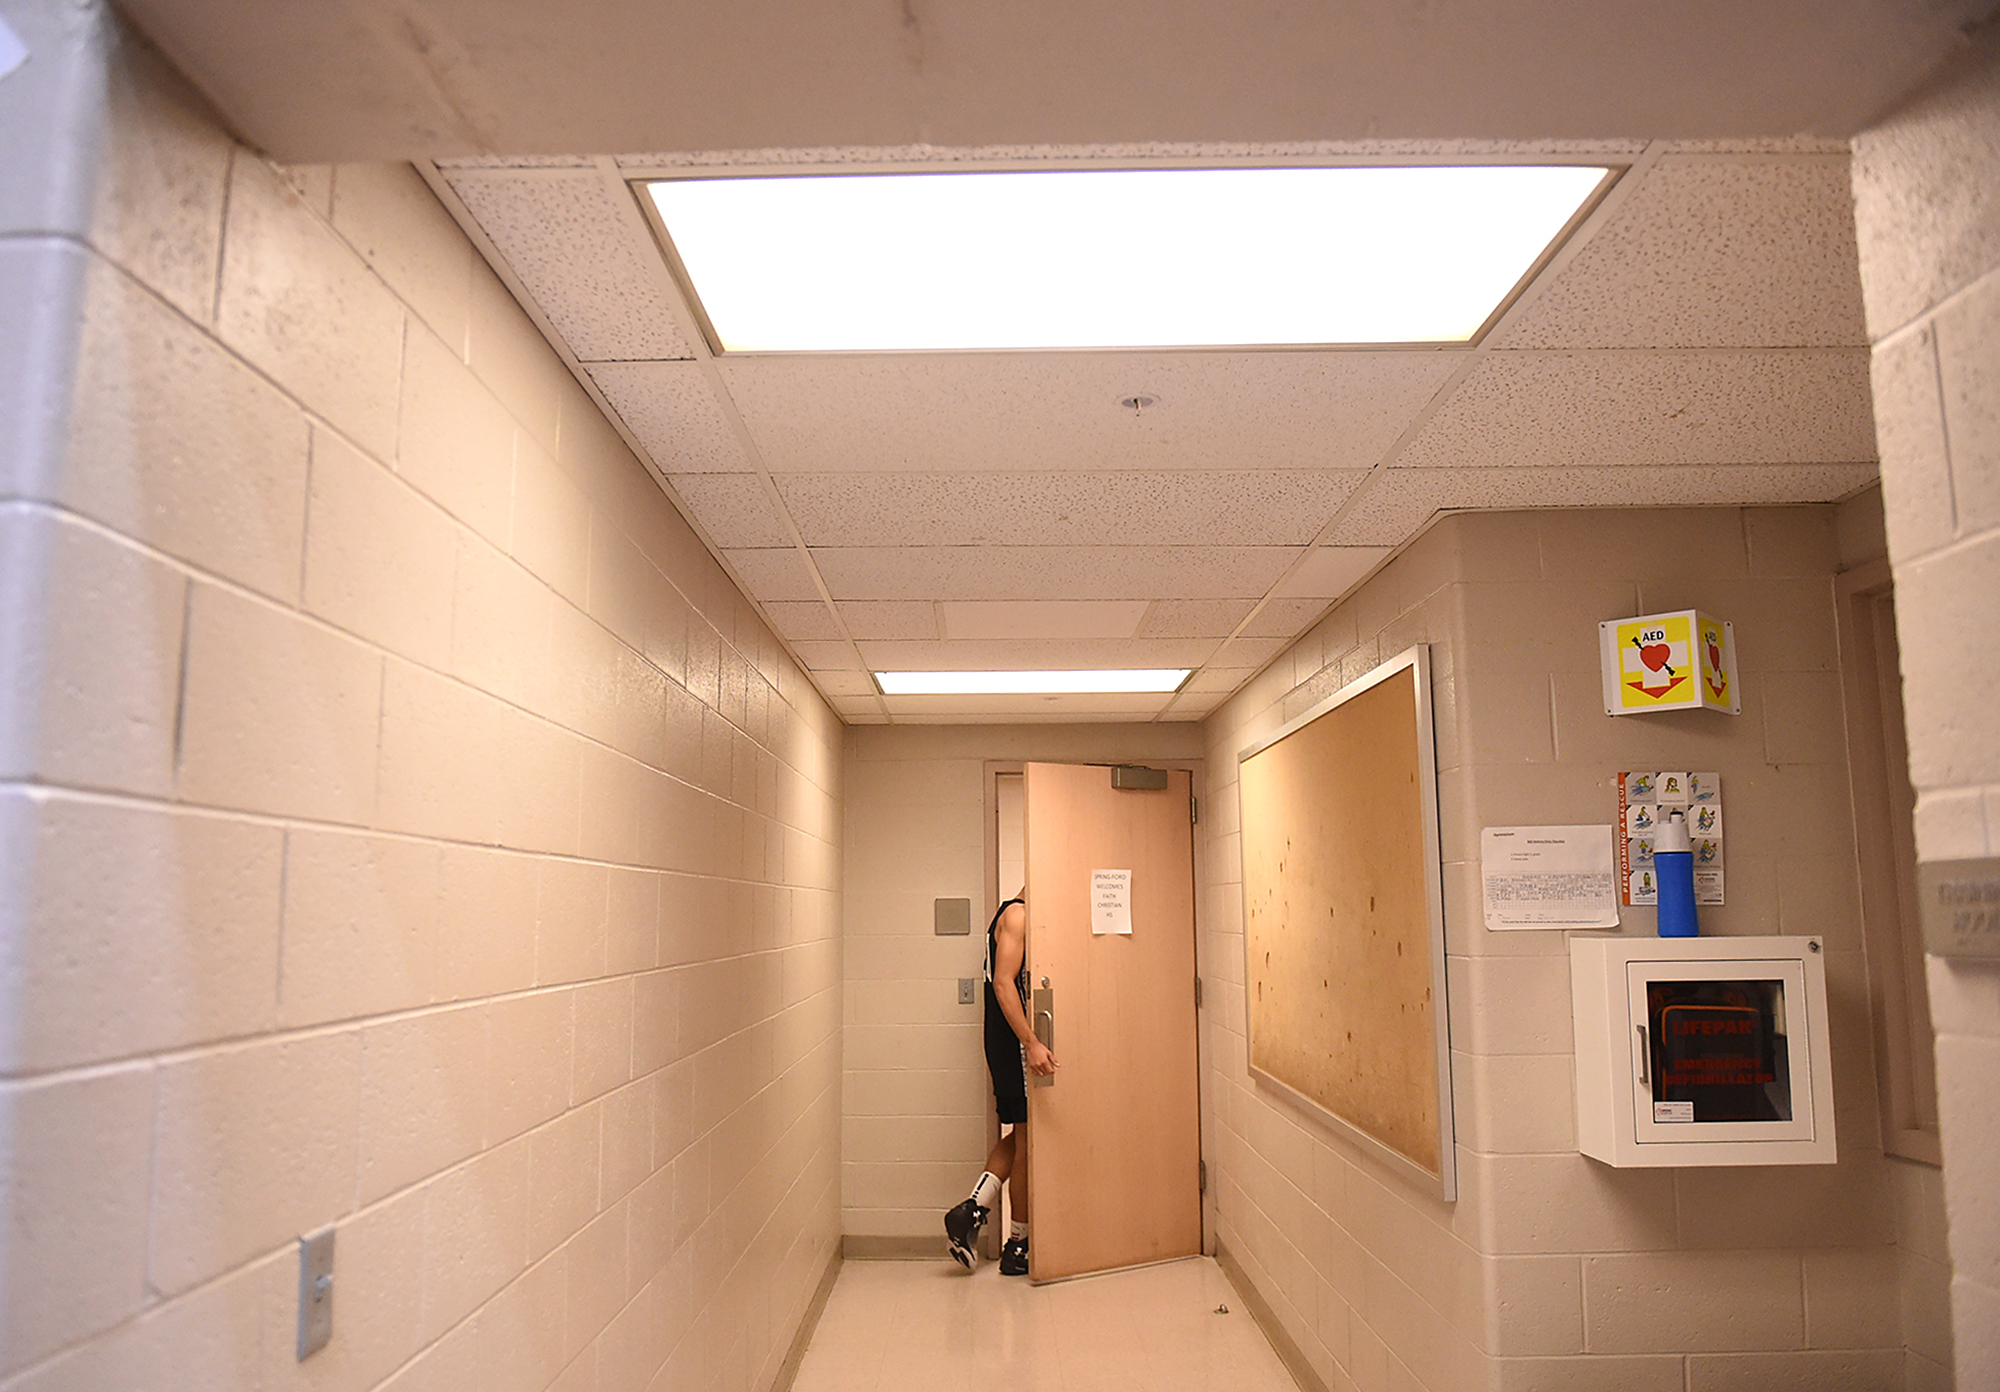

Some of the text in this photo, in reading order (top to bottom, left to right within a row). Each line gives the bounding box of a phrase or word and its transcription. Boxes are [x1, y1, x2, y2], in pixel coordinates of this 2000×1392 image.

[1642, 630, 1664, 642] AED
[1620, 831, 1629, 893] PERFORMING
[1672, 1020, 1752, 1035] LIFEPAK
[1674, 1058, 1762, 1070] EMERGENCY
[1665, 1073, 1774, 1085] DEFIBRILLATOR
